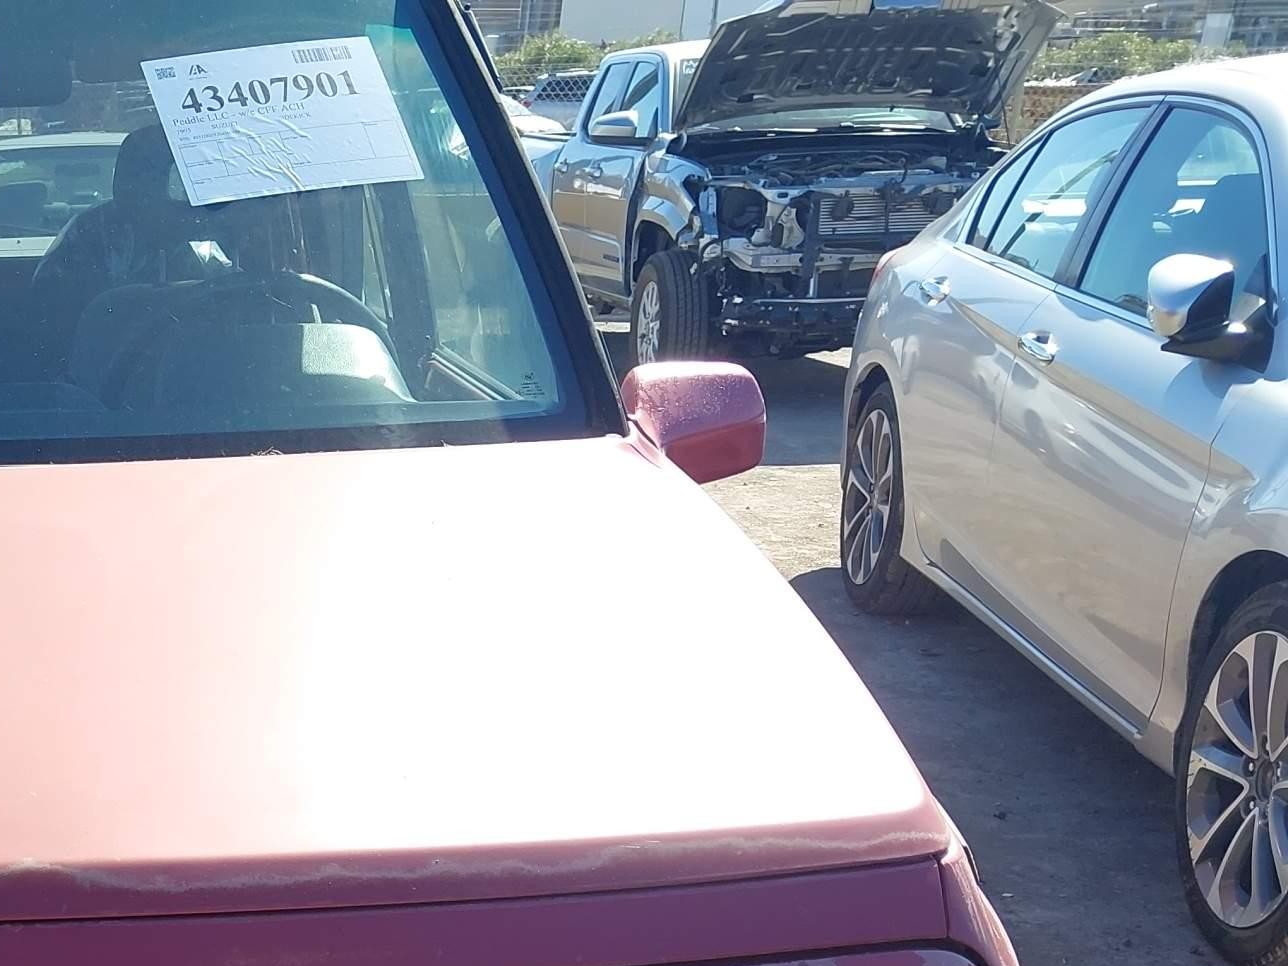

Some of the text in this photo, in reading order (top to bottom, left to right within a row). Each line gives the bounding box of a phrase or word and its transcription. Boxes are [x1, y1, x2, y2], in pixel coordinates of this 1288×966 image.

[181, 70, 361, 114] 43407901
[172, 115, 206, 127] Peddle
[206, 111, 229, 122] LLC
[281, 102, 305, 112] ACH
